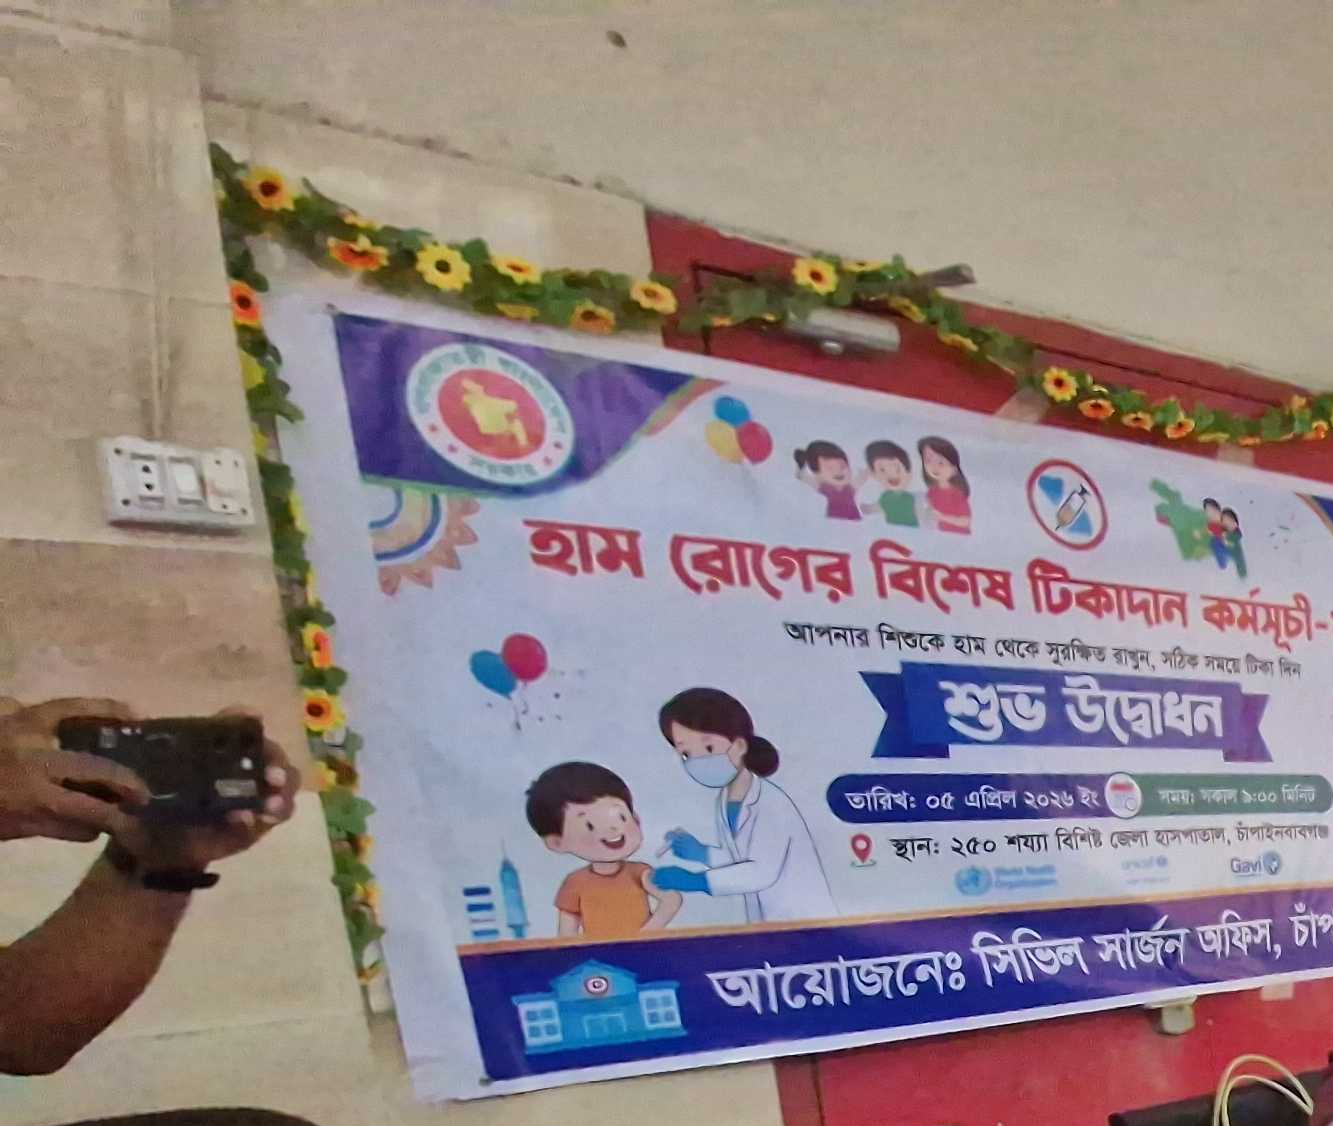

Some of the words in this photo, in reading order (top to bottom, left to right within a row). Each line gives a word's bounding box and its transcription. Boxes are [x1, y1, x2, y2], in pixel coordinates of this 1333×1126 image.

[523, 519, 645, 578] হাম
[670, 533, 854, 603] রোগের
[870, 539, 1015, 614] বিশেষ
[1027, 557, 1189, 628] টিকাদান
[783, 620, 870, 649] আপনার
[878, 622, 945, 653] শিশুকে
[951, 634, 986, 656] হাম
[995, 638, 1039, 659] থেকে
[1044, 638, 1106, 667] সুরক্ষিত
[1112, 647, 1156, 672] রাখুন,
[1161, 646, 1200, 670] সঠিক
[939, 680, 1047, 742] শুভ
[1062, 673, 1224, 745] উদ্বোধন
[926, 791, 955, 810] ০৫
[964, 784, 1017, 810] এপ্রিল
[1023, 790, 1075, 810] ২০২৬
[951, 836, 997, 858] ২৫০
[1004, 833, 1048, 853] শয্যা
[1110, 829, 1149, 850] জেলা
[1230, 857, 1263, 875] Gavi
[970, 927, 1091, 988] সিভিল
[1095, 914, 1190, 970] সার্জন
[1196, 908, 1282, 961] অফিস,
